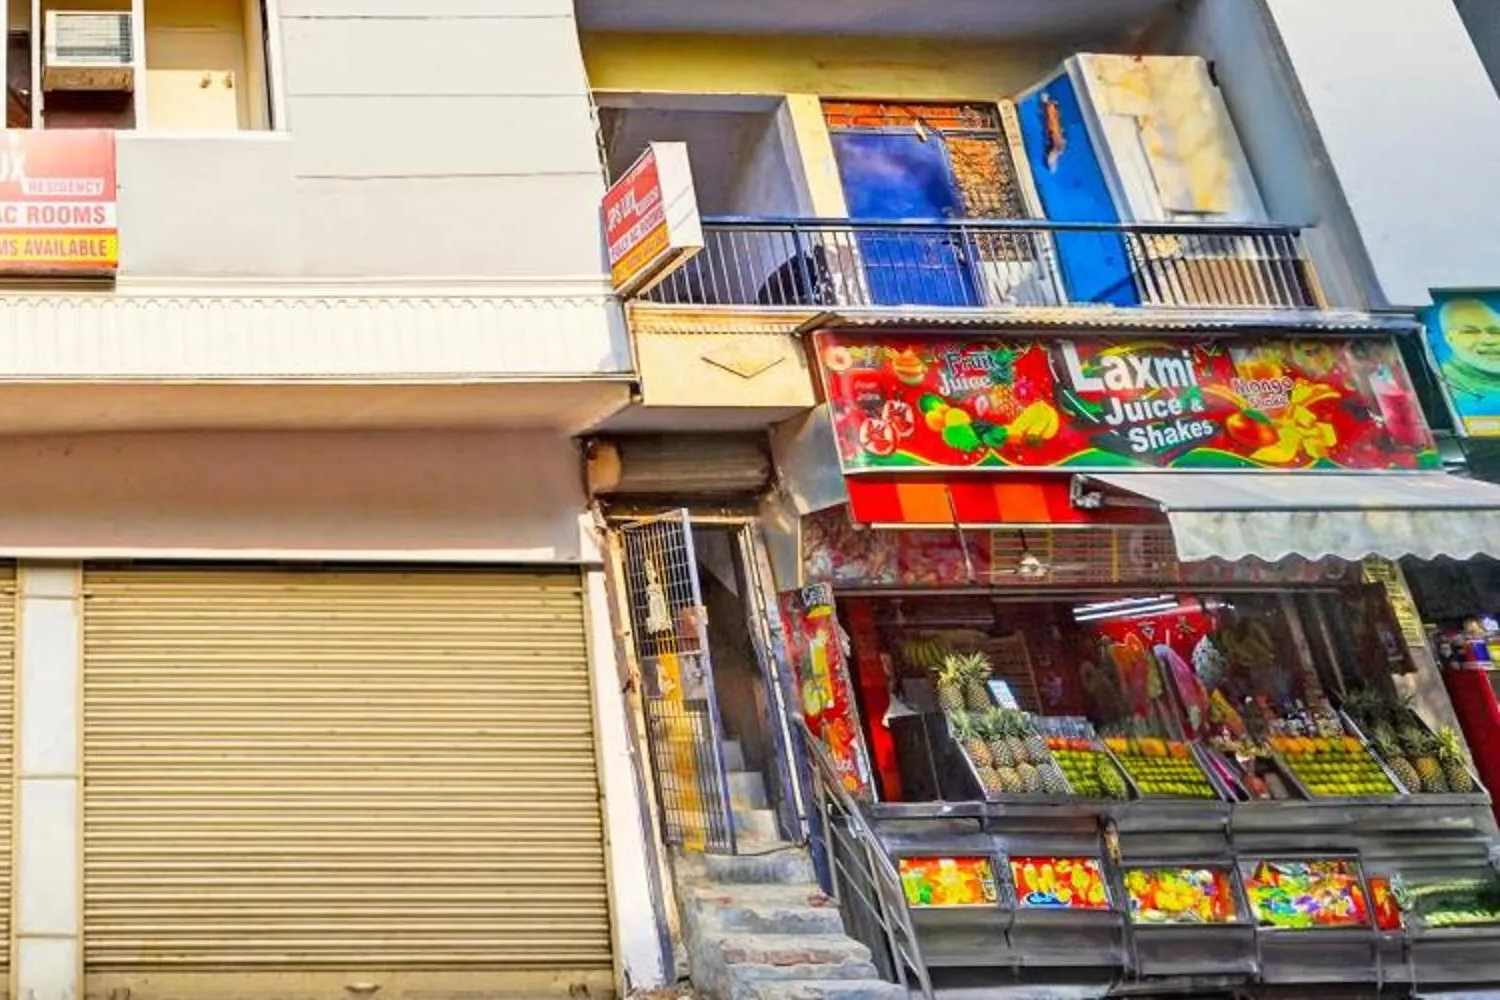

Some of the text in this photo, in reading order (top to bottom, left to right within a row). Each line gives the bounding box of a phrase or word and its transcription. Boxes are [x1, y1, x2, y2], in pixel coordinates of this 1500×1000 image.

[28, 179, 102, 194] RESIDENCY
[27, 205, 106, 225] ROOMS
[24, 238, 108, 257] AVAILABLE
[946, 354, 995, 378] Fruit
[1061, 340, 1198, 392] Laxmi
[939, 373, 993, 396] Juice
[1230, 376, 1293, 394] Mango
[1105, 396, 1205, 425] Juice &
[1127, 419, 1214, 453] Shakes
